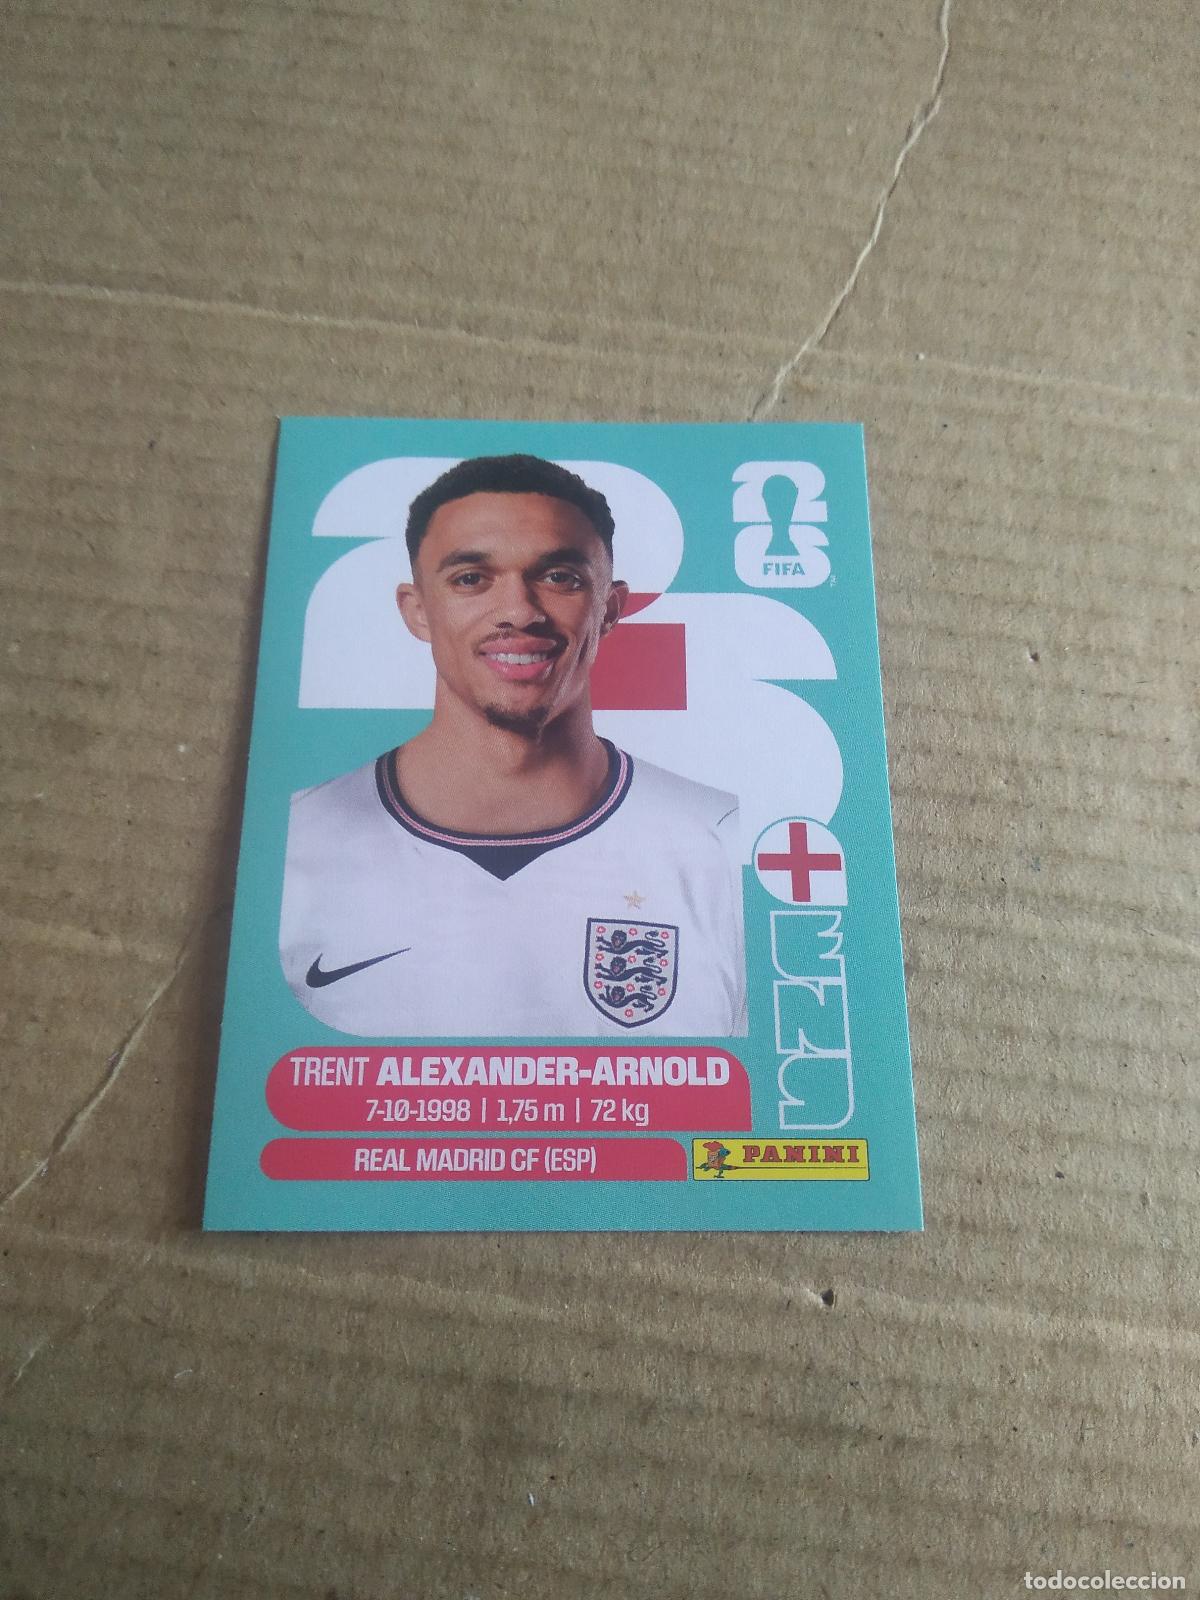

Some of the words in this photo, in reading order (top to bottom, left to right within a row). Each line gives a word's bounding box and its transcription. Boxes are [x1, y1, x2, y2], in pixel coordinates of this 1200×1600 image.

[763, 562, 806, 576] FIFA
[290, 1056, 370, 1086] TRENT
[376, 1056, 730, 1086] ALEXANDER-ARNOLD
[366, 1098, 471, 1122] 7-10-1998
[497, 1098, 538, 1125] 1,75
[543, 1103, 565, 1122] m
[591, 1098, 616, 1122] 72
[622, 1098, 649, 1126] kg
[354, 1148, 411, 1172] REAL
[416, 1148, 505, 1172] MADRID
[510, 1148, 540, 1172] CF
[544, 1146, 597, 1174] (ESP)
[742, 1145, 859, 1163] PANINI
